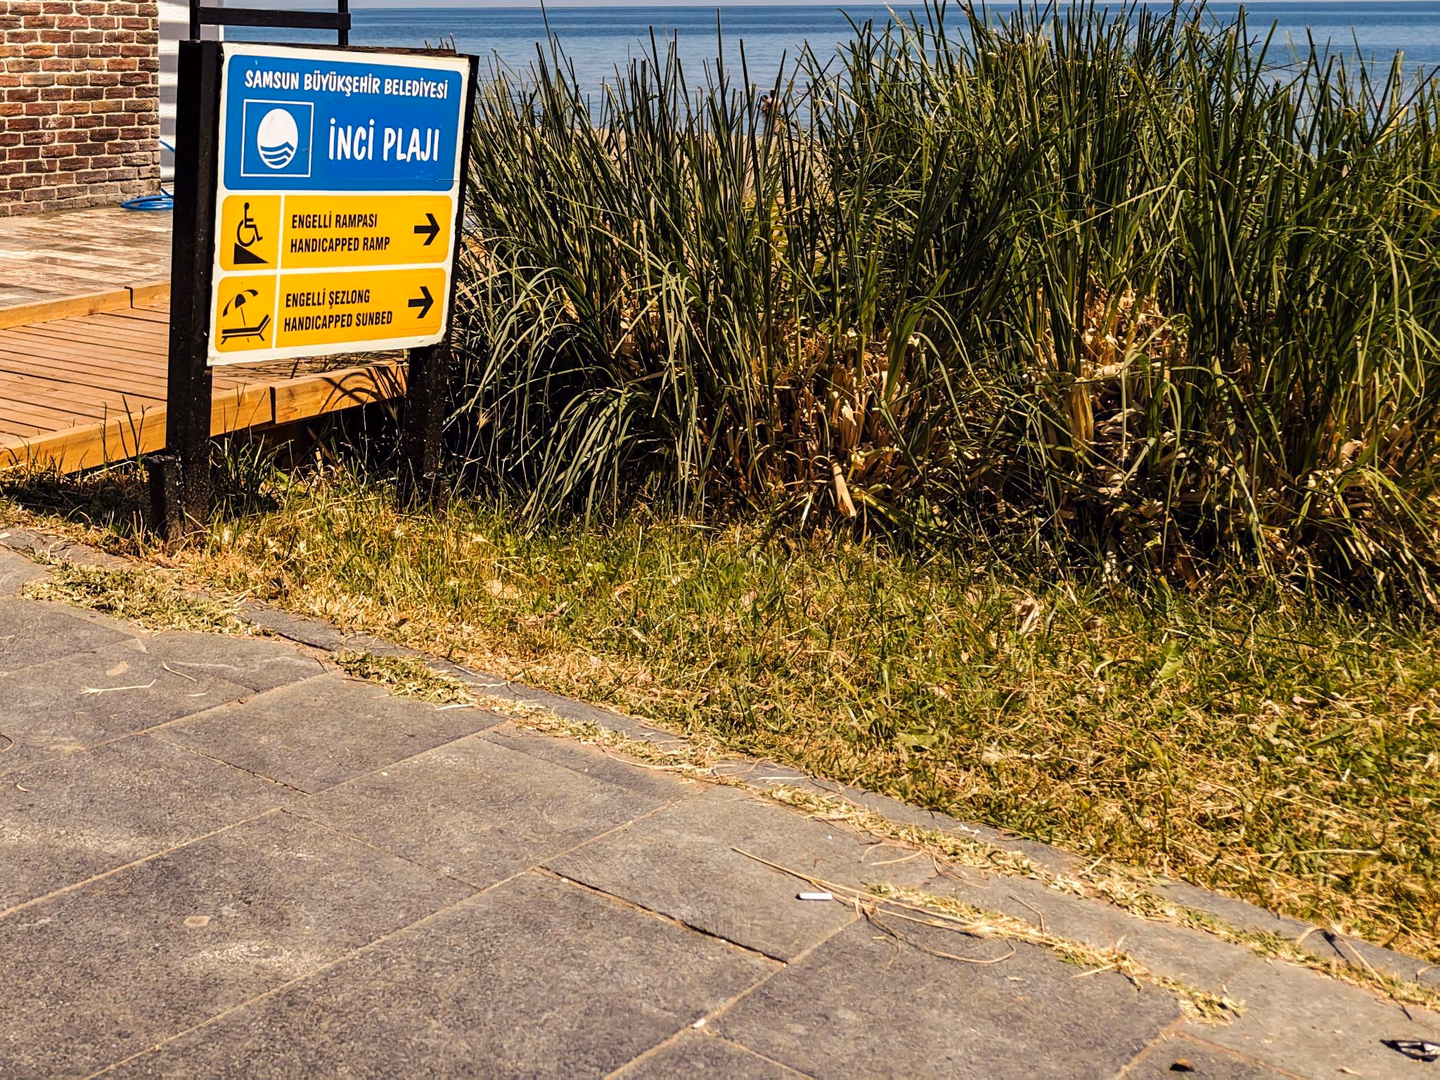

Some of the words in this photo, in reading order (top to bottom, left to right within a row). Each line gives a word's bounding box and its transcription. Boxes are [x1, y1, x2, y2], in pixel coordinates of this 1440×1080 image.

[244, 70, 300, 90] SAMSUN
[303, 70, 381, 97] BÜYÜKŞEHİR
[383, 77, 449, 100] BELEDİYESİ
[328, 117, 375, 161] İNCİ
[382, 126, 440, 163] PLAJI
[291, 210, 332, 229] ENGELLİ
[335, 213, 378, 228] RAMPASI
[290, 237, 360, 253] HANDICAPPED
[362, 236, 391, 251] RAMP
[285, 287, 326, 308] ENGELLİ
[328, 289, 370, 310] ŞEZLONG
[283, 313, 353, 332] HANDICAPPED
[355, 310, 393, 327] SUNBED
